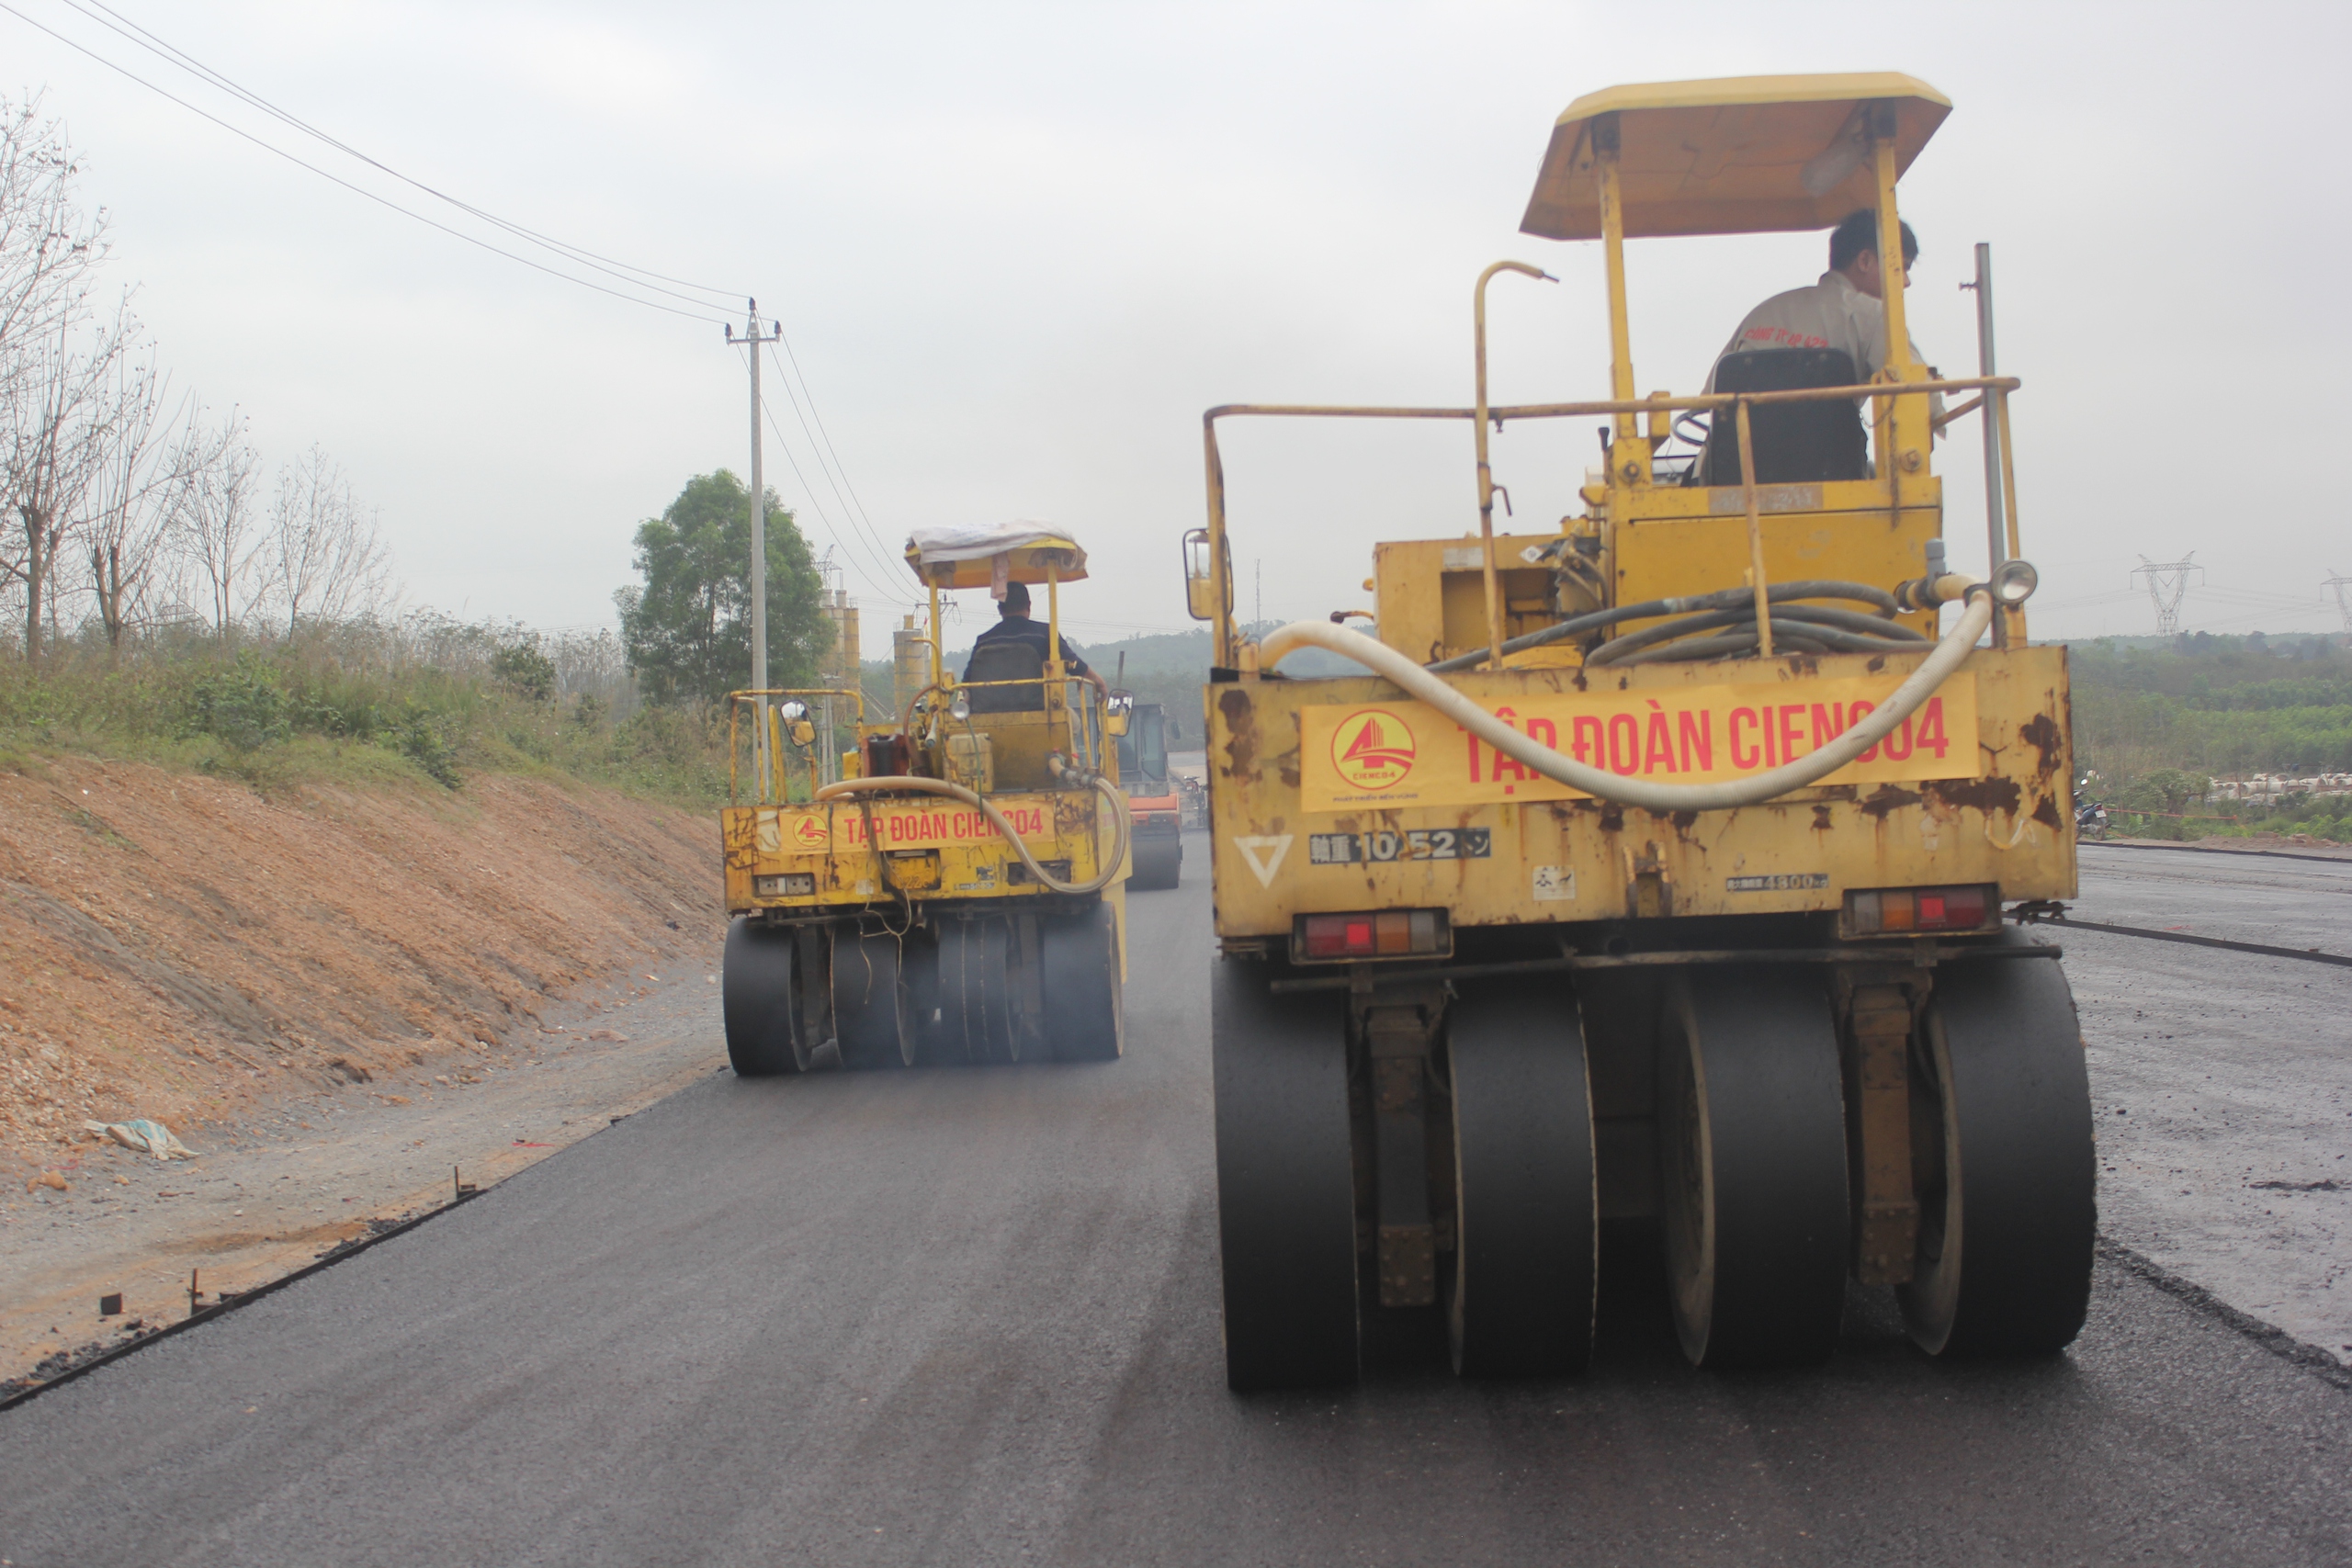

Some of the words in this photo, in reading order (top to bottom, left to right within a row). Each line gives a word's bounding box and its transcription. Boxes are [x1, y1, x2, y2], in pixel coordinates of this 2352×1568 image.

[1457, 706, 1557, 795] TẬP
[1572, 699, 1713, 776] ĐOÀN
[1728, 696, 1950, 771] CIENCO4
[844, 813, 885, 849] TẬP
[890, 809, 947, 841] ĐOÀN
